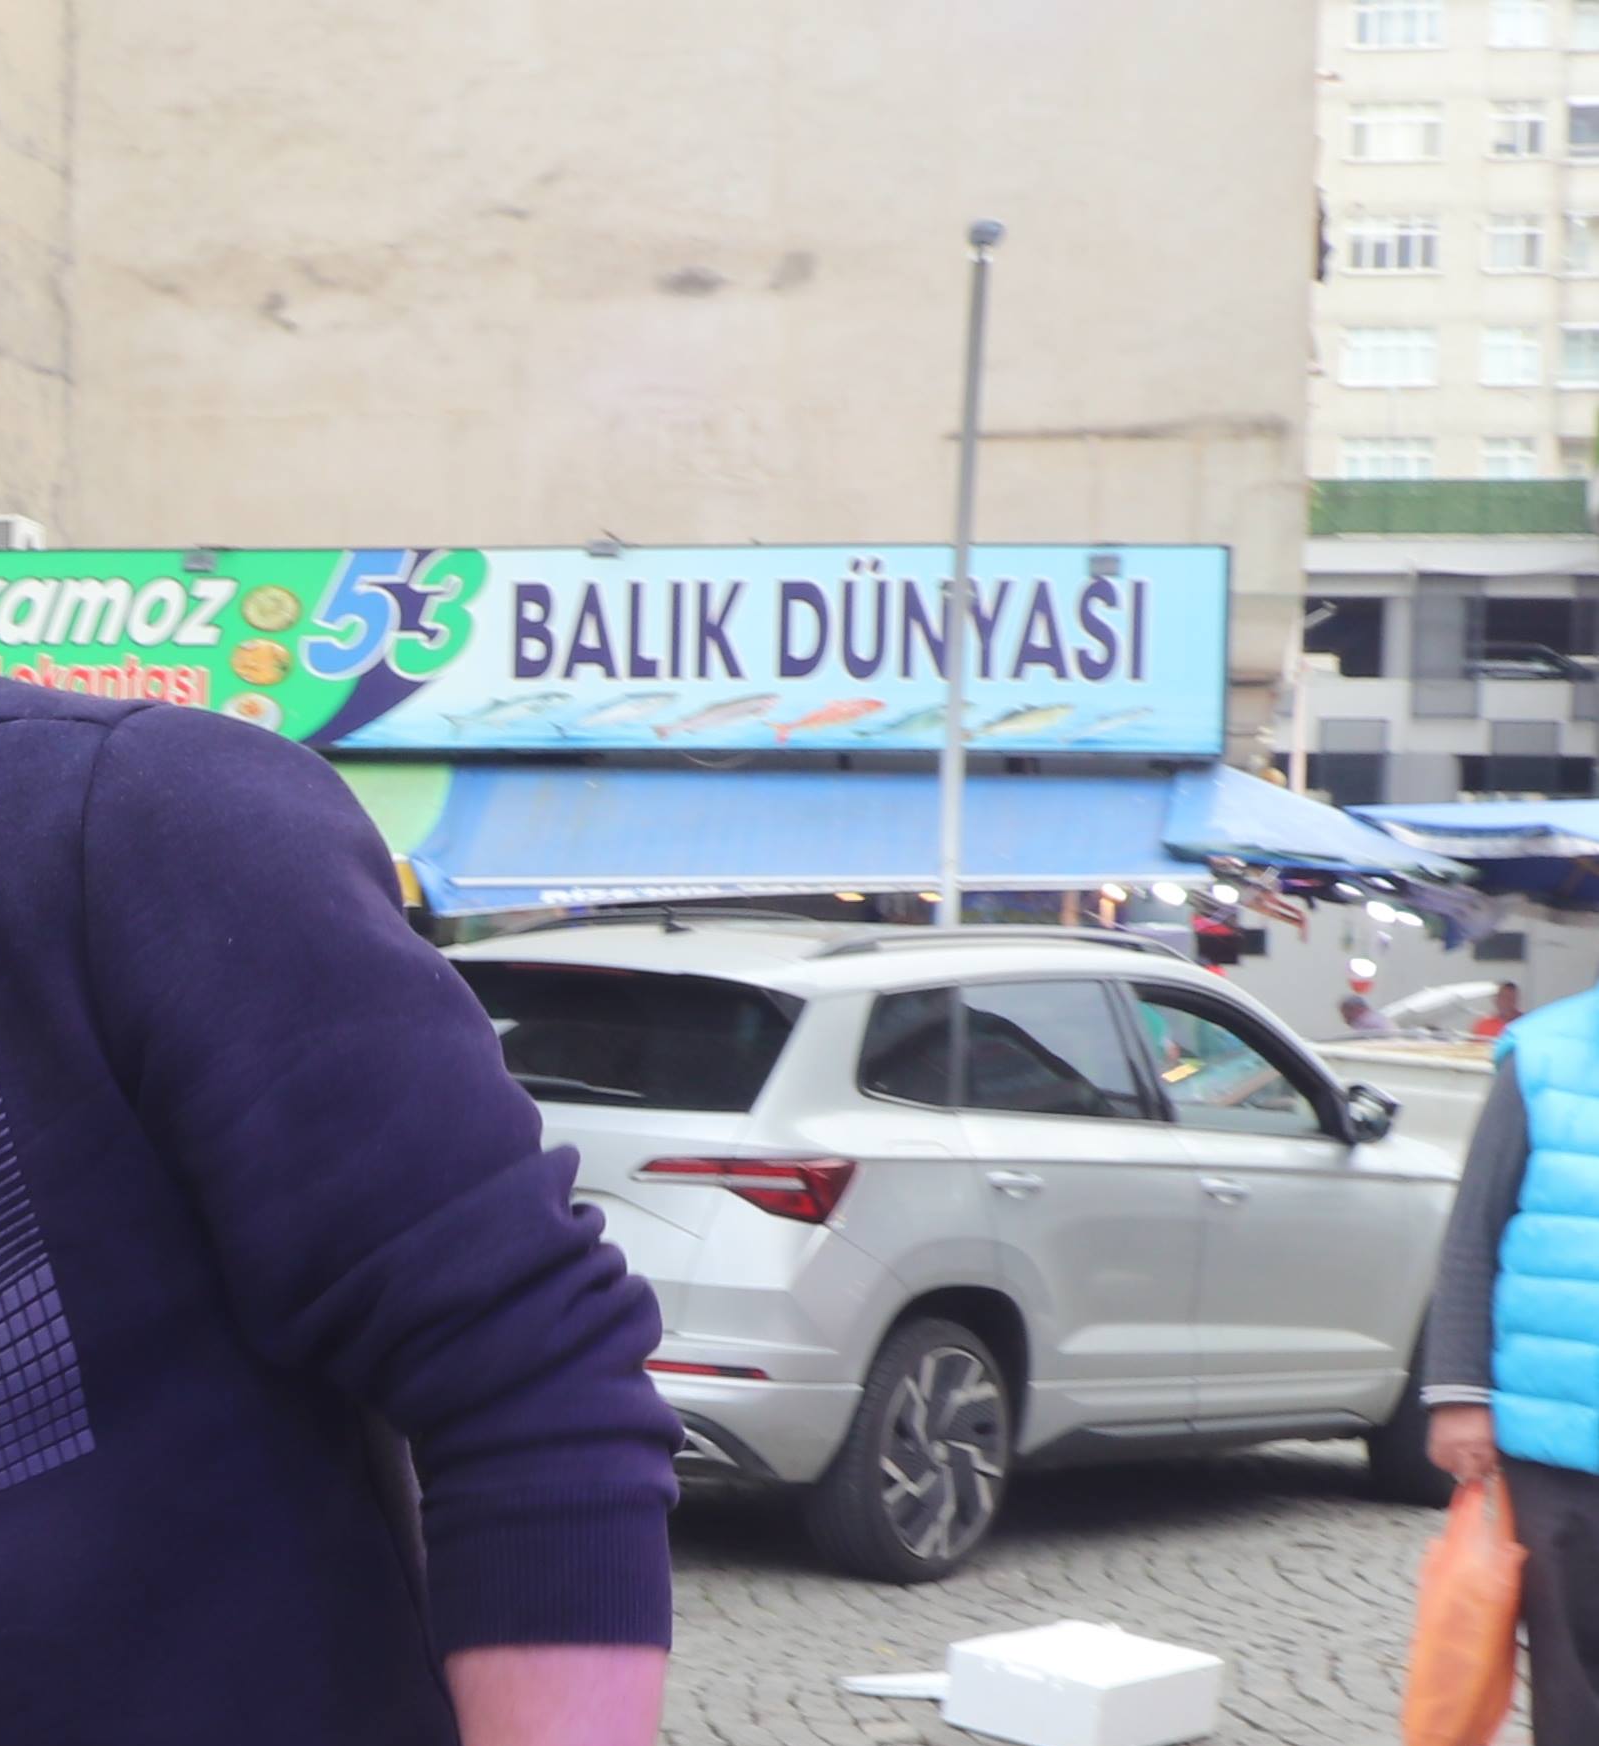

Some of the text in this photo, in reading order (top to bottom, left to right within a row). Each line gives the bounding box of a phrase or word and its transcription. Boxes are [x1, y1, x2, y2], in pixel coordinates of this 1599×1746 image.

[300, 549, 489, 681] 53
[512, 558, 1149, 681] BALIK DÜNYASI
